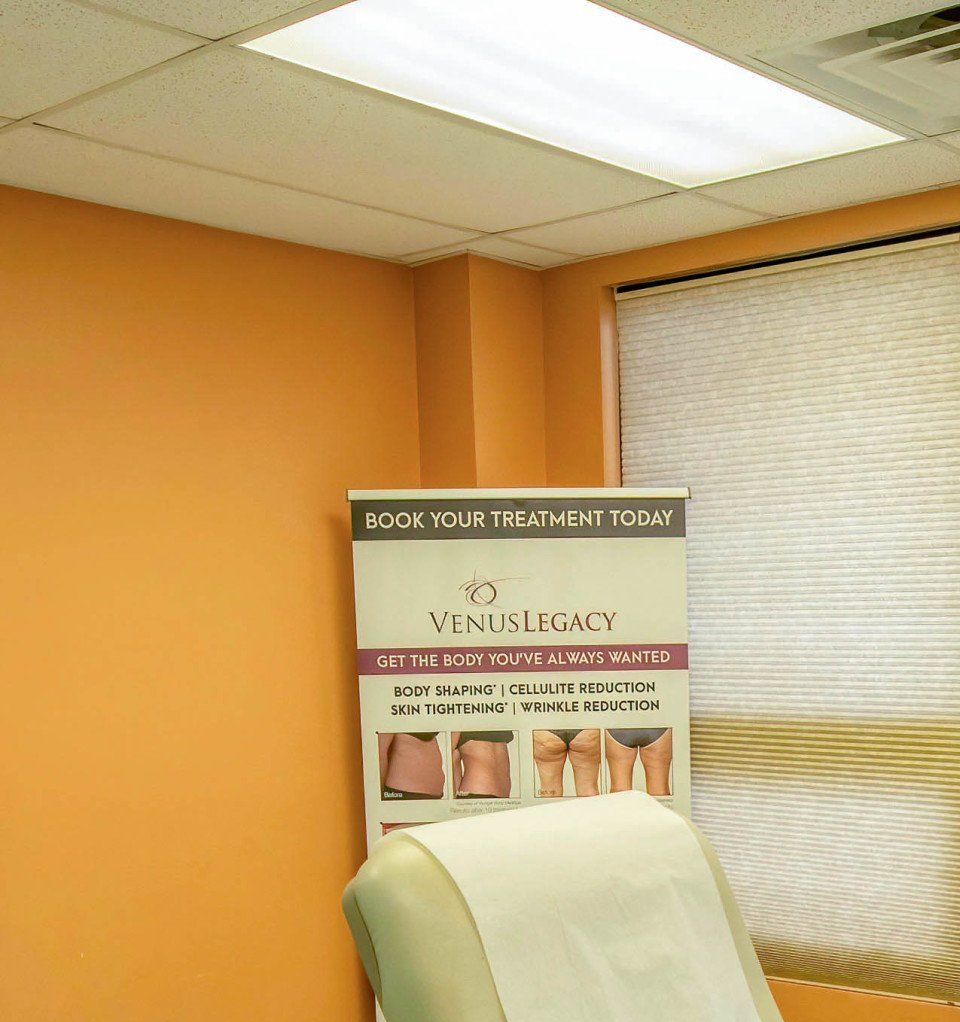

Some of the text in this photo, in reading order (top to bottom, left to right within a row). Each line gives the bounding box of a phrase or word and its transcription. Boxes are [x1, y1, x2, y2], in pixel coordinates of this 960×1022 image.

[365, 509, 674, 529] BOOK YOUR TREATMENT TODAY
[377, 650, 671, 668] GET THE BODY YOU'VE ALWAYS WANTED
[394, 685, 431, 697] BODY
[509, 683, 575, 695] CELLULITE
[579, 682, 656, 694] REDUCTION
[391, 704, 421, 716] SKIN
[521, 701, 579, 713] WRINKLE
[584, 700, 660, 712] REDUCTION
